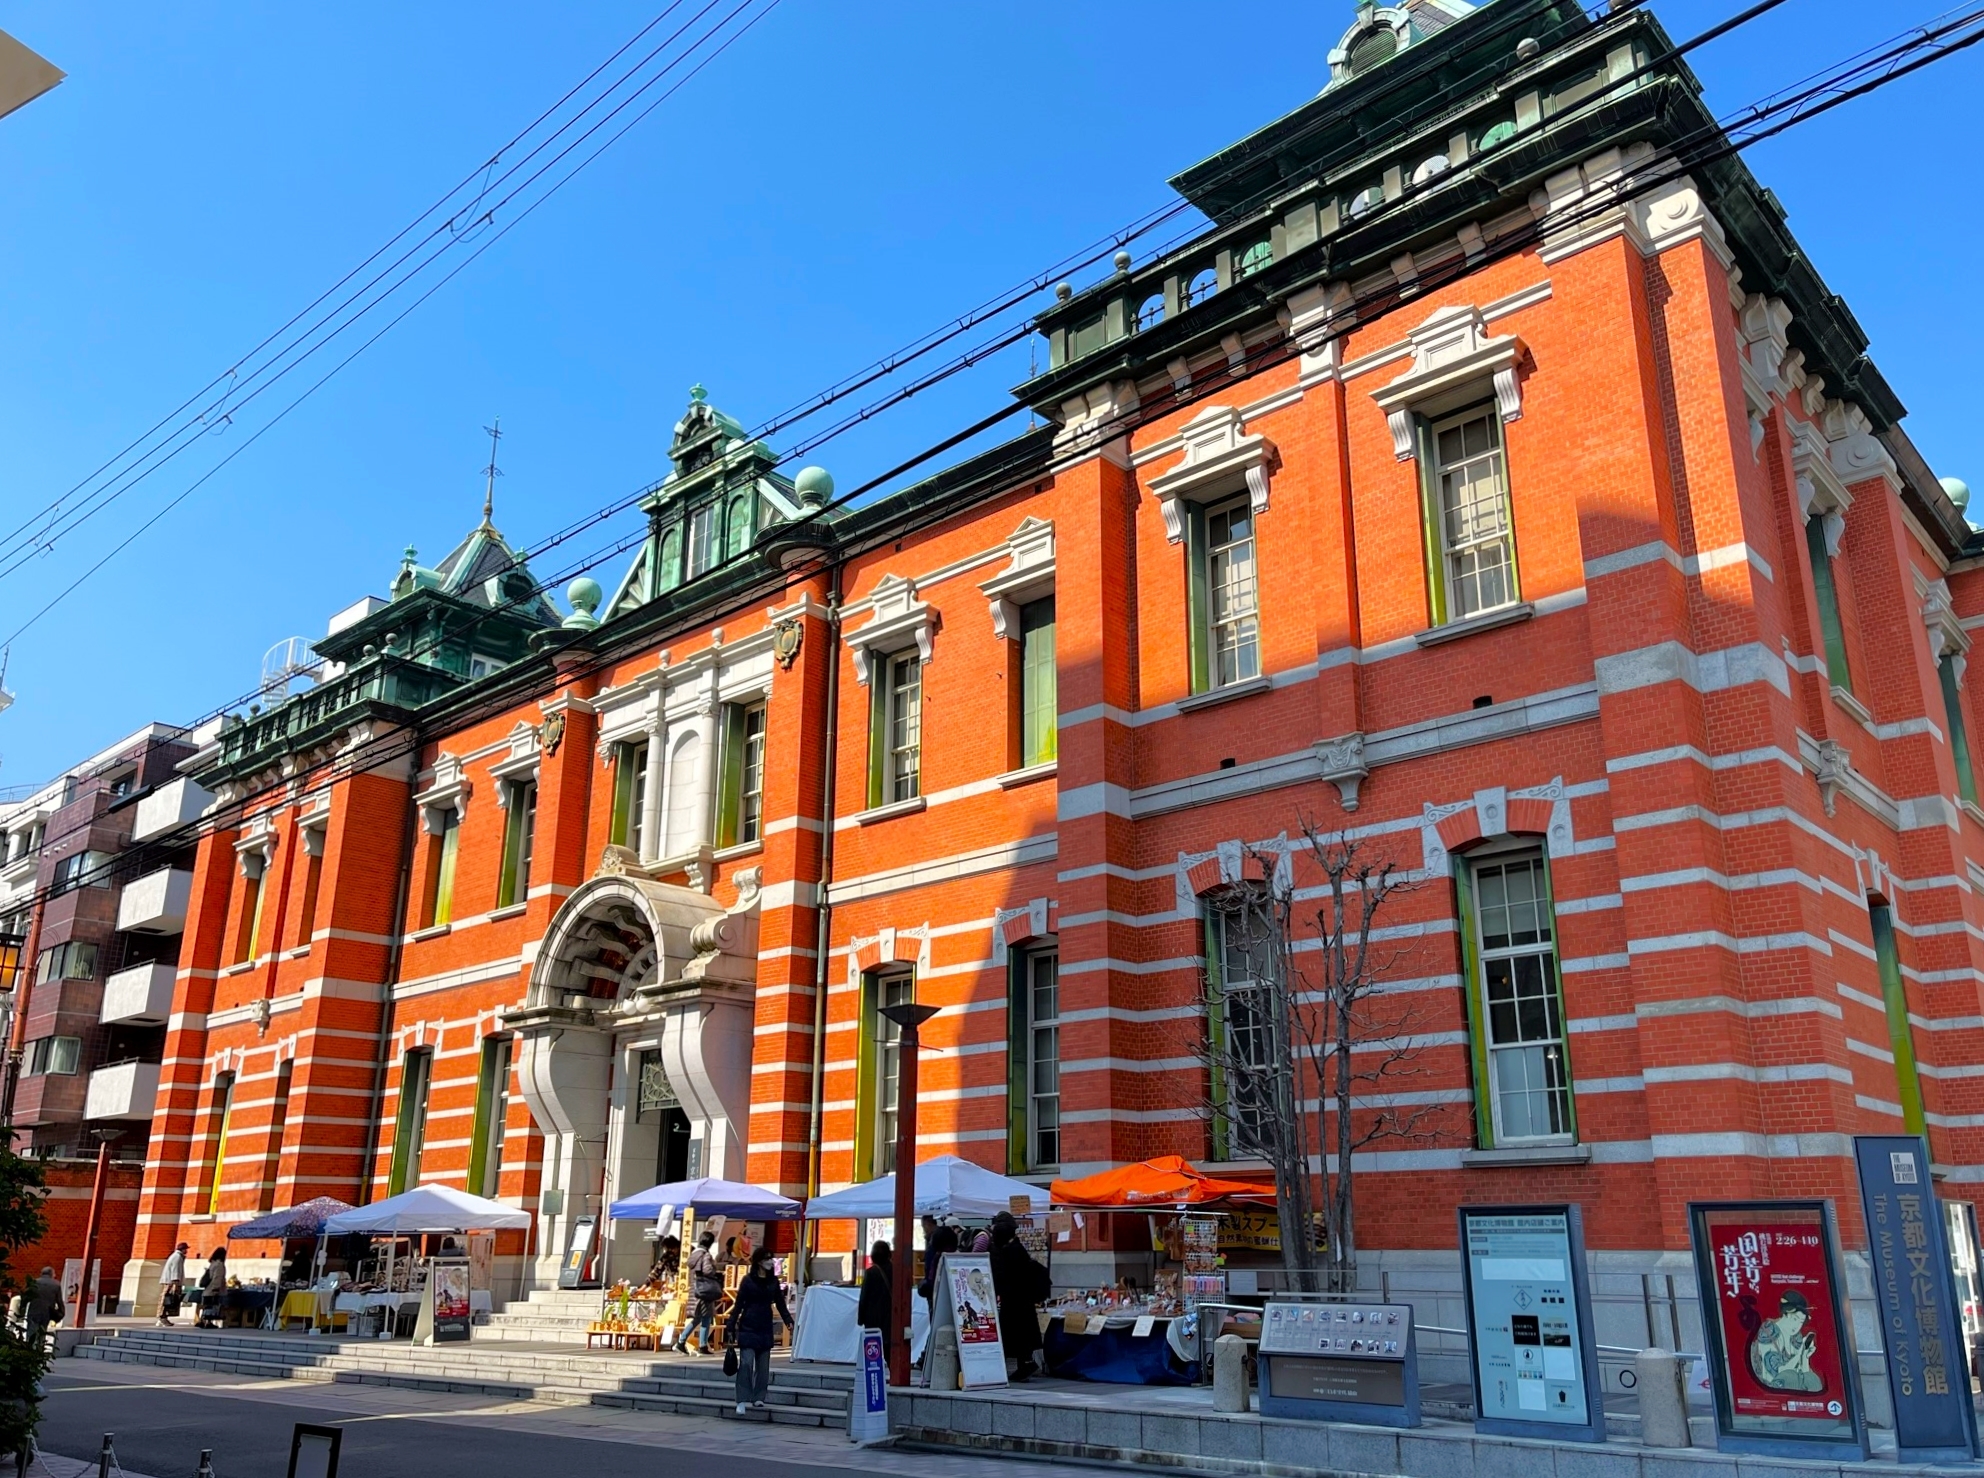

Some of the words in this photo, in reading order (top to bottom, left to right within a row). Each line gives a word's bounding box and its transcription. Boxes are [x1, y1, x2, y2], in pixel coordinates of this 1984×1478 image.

[1894, 1164, 1914, 1172] MUSEUM
[1873, 1193, 1888, 1225] The
[1879, 1231, 1901, 1311] Museum
[1897, 1193, 1949, 1394] 京都文化博物館
[1892, 1316, 1908, 1335] of
[1894, 1341, 1914, 1396] Kyoto
